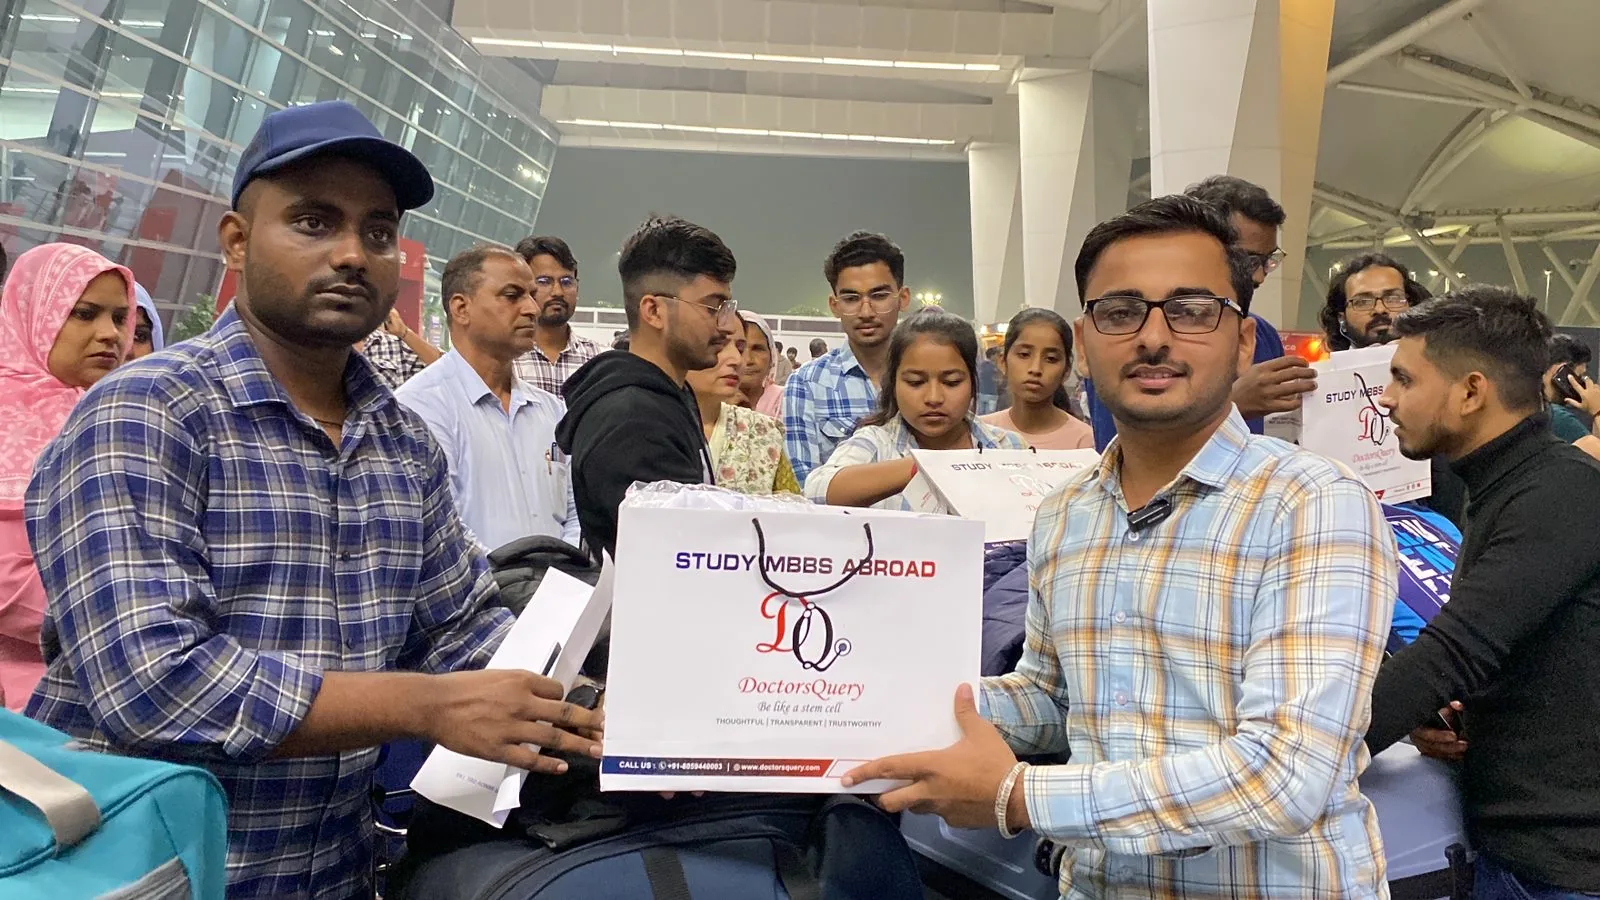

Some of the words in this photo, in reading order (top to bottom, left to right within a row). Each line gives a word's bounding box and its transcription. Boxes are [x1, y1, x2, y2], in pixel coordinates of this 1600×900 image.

[1325, 391, 1357, 403] STUDY
[951, 463, 992, 471] STUDY
[675, 552, 757, 572] STUDY
[764, 556, 833, 575] MBBS
[841, 558, 937, 578] ABROAD
[738, 676, 865, 701] DoctorsQuery
[757, 702, 770, 712] Be
[773, 701, 791, 715] like
[793, 704, 799, 713] a
[802, 704, 823, 713] stem
[825, 702, 843, 713] cell
[716, 718, 765, 726] THOUGHTFUL
[771, 719, 822, 728] TRANSPARENT
[828, 720, 882, 729] TRUSTWORTHY
[619, 761, 639, 769] CALL
